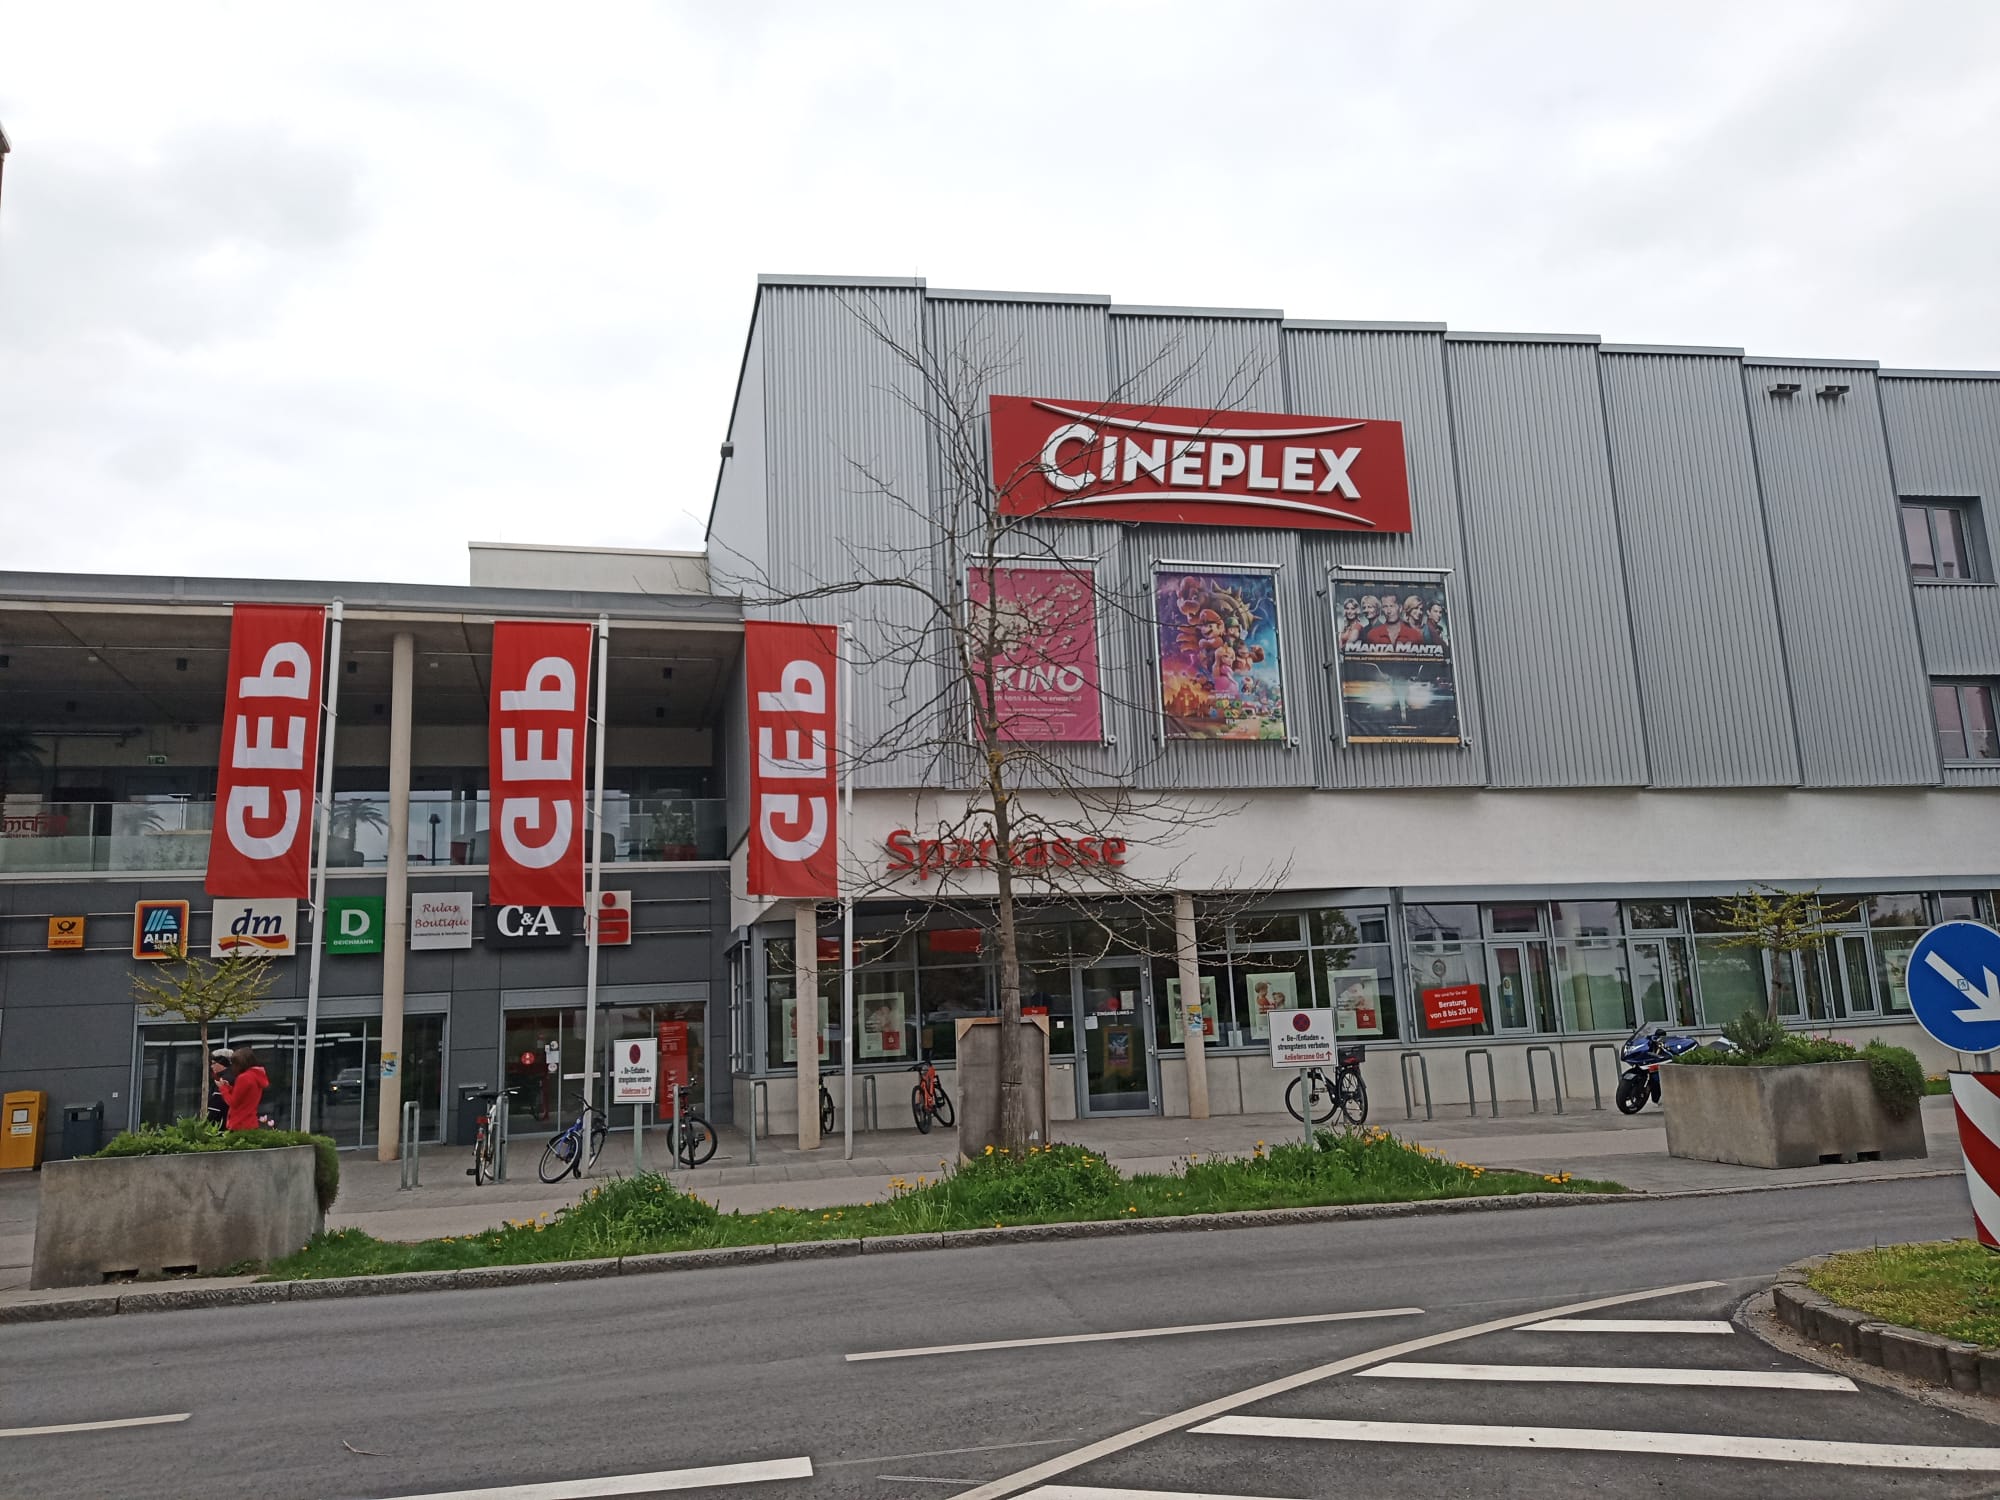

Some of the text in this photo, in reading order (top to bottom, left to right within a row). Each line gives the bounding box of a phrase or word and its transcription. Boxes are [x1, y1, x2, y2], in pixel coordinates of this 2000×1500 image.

[1040, 423, 1363, 500] CINEPLEX
[1344, 640, 1444, 654] MANTA MANTA
[994, 665, 1084, 692] KINO
[231, 908, 282, 935] dm
[340, 908, 371, 937] D
[414, 917, 470, 929] Boutique
[497, 905, 561, 937] C&A
[143, 932, 178, 944] ALDI
[1438, 1000, 1467, 1008] Beratung
[1448, 1009, 1457, 1017] bis
[1277, 1043, 1307, 1051] strengstens
